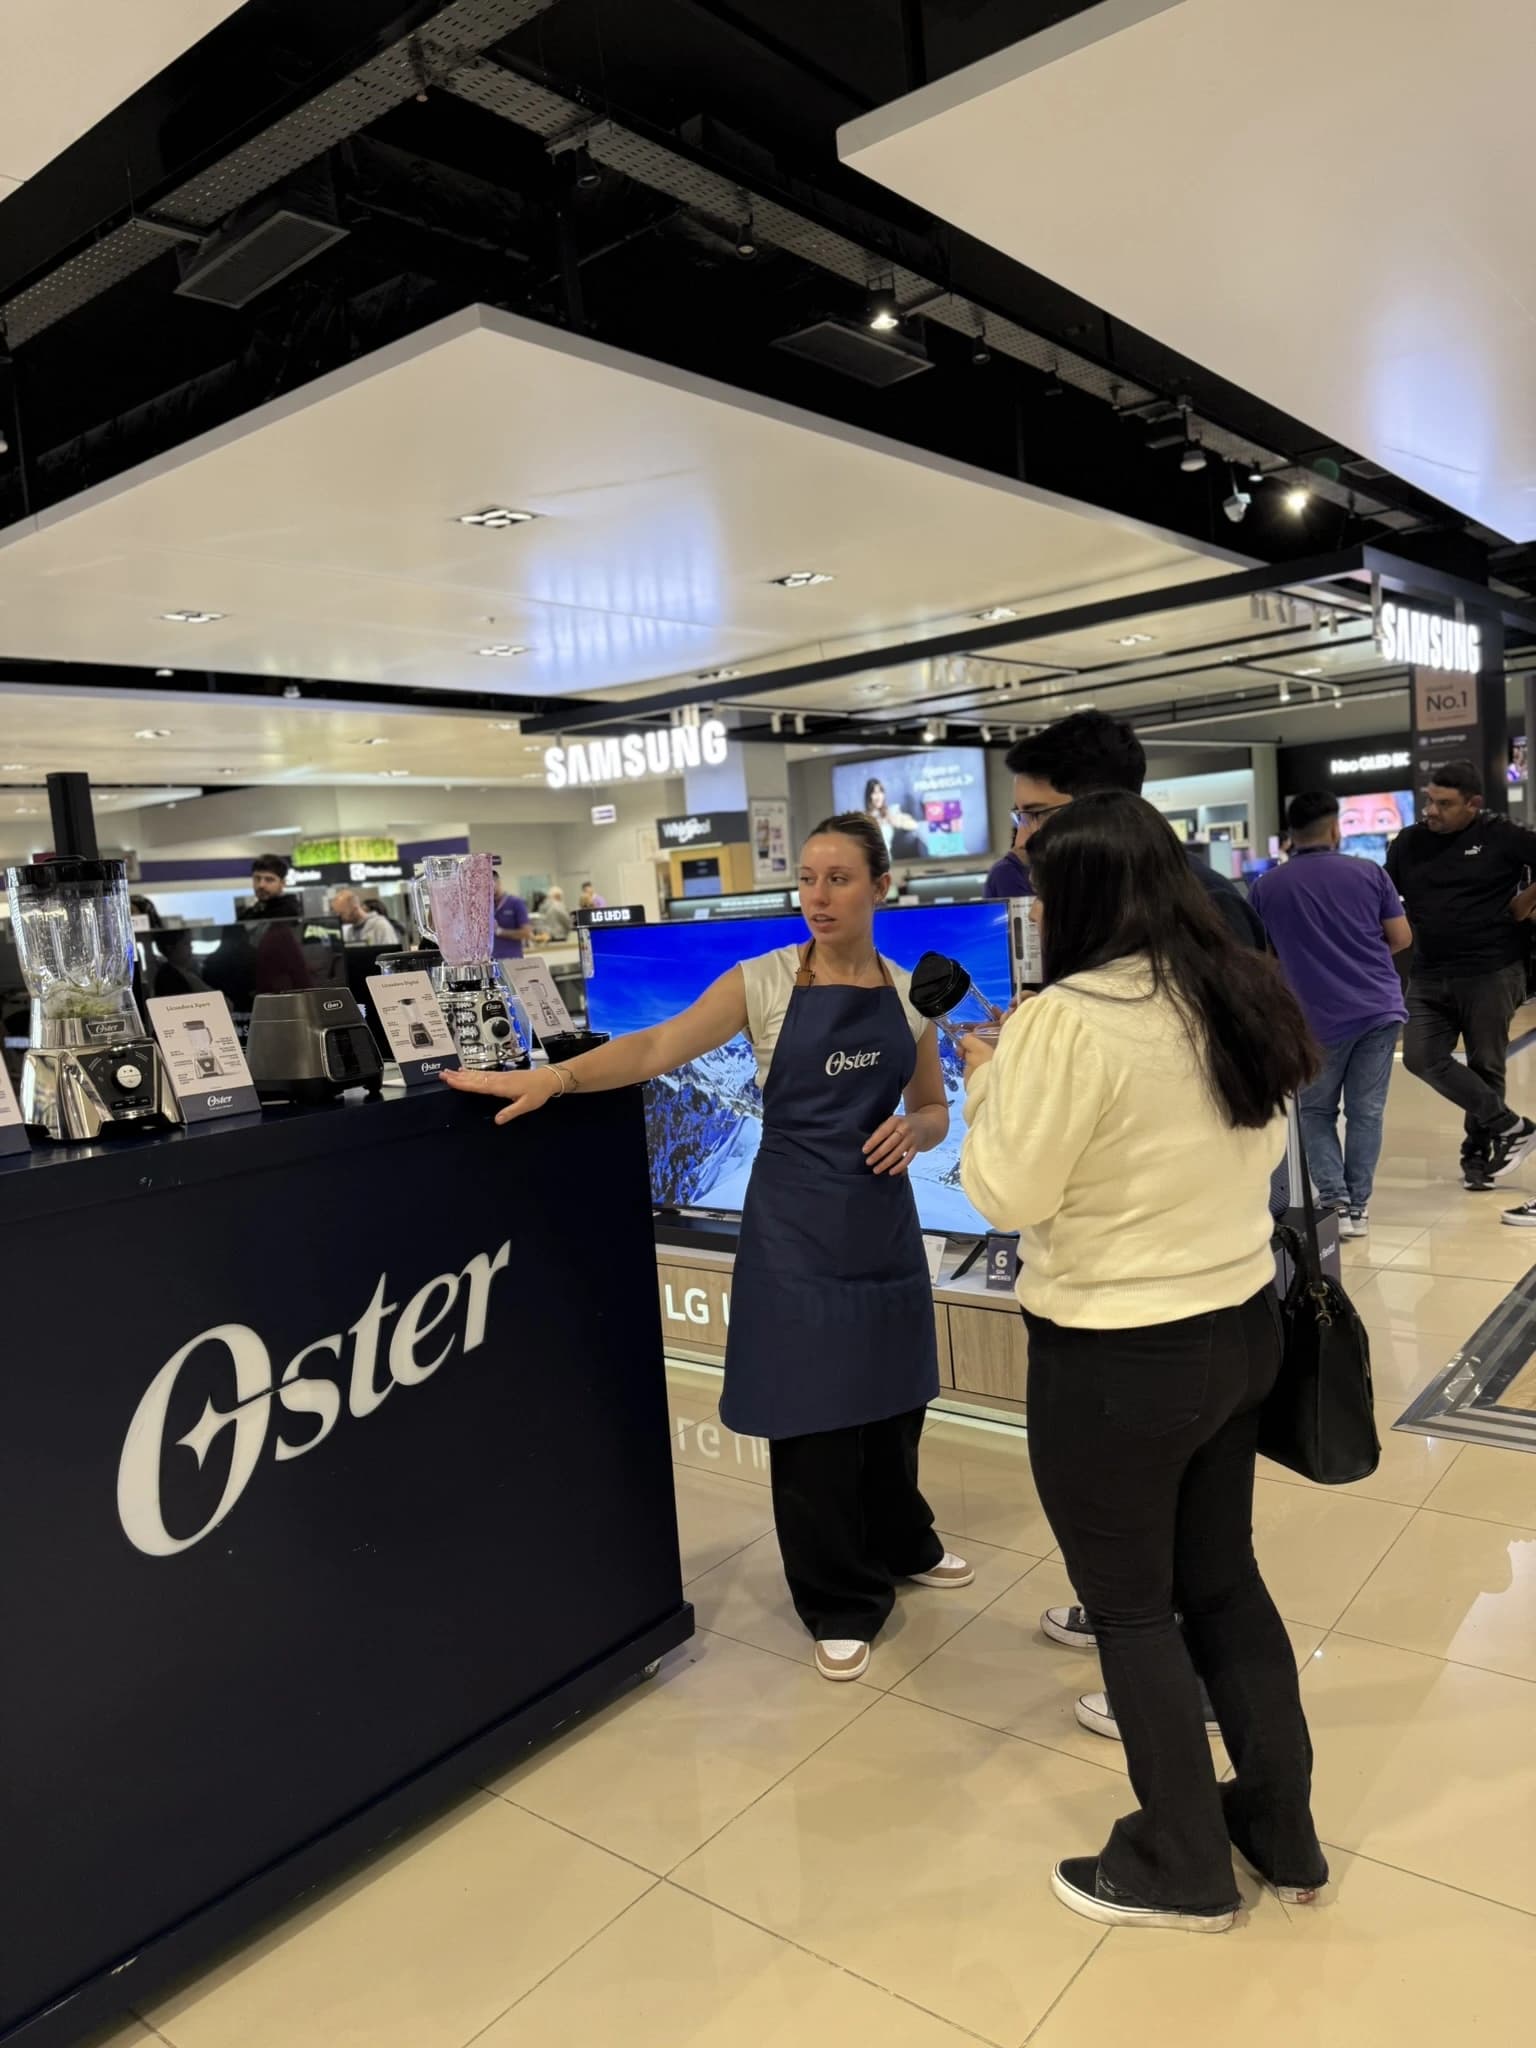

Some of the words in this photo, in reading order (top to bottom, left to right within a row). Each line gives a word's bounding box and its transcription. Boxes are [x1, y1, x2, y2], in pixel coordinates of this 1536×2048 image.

[1380, 602, 1481, 675] SAMSUNG
[1426, 691, 1468, 712] No.1
[544, 720, 728, 789] SAMSUNG
[591, 911, 604, 922] LG
[95, 1022, 118, 1034] Oster
[421, 1062, 441, 1073] Oster
[825, 1050, 880, 1076] Oster
[207, 1095, 232, 1107] Oster
[995, 1250, 1008, 1268] 6
[664, 1285, 710, 1325] LG
[117, 1239, 511, 1557] Oster
